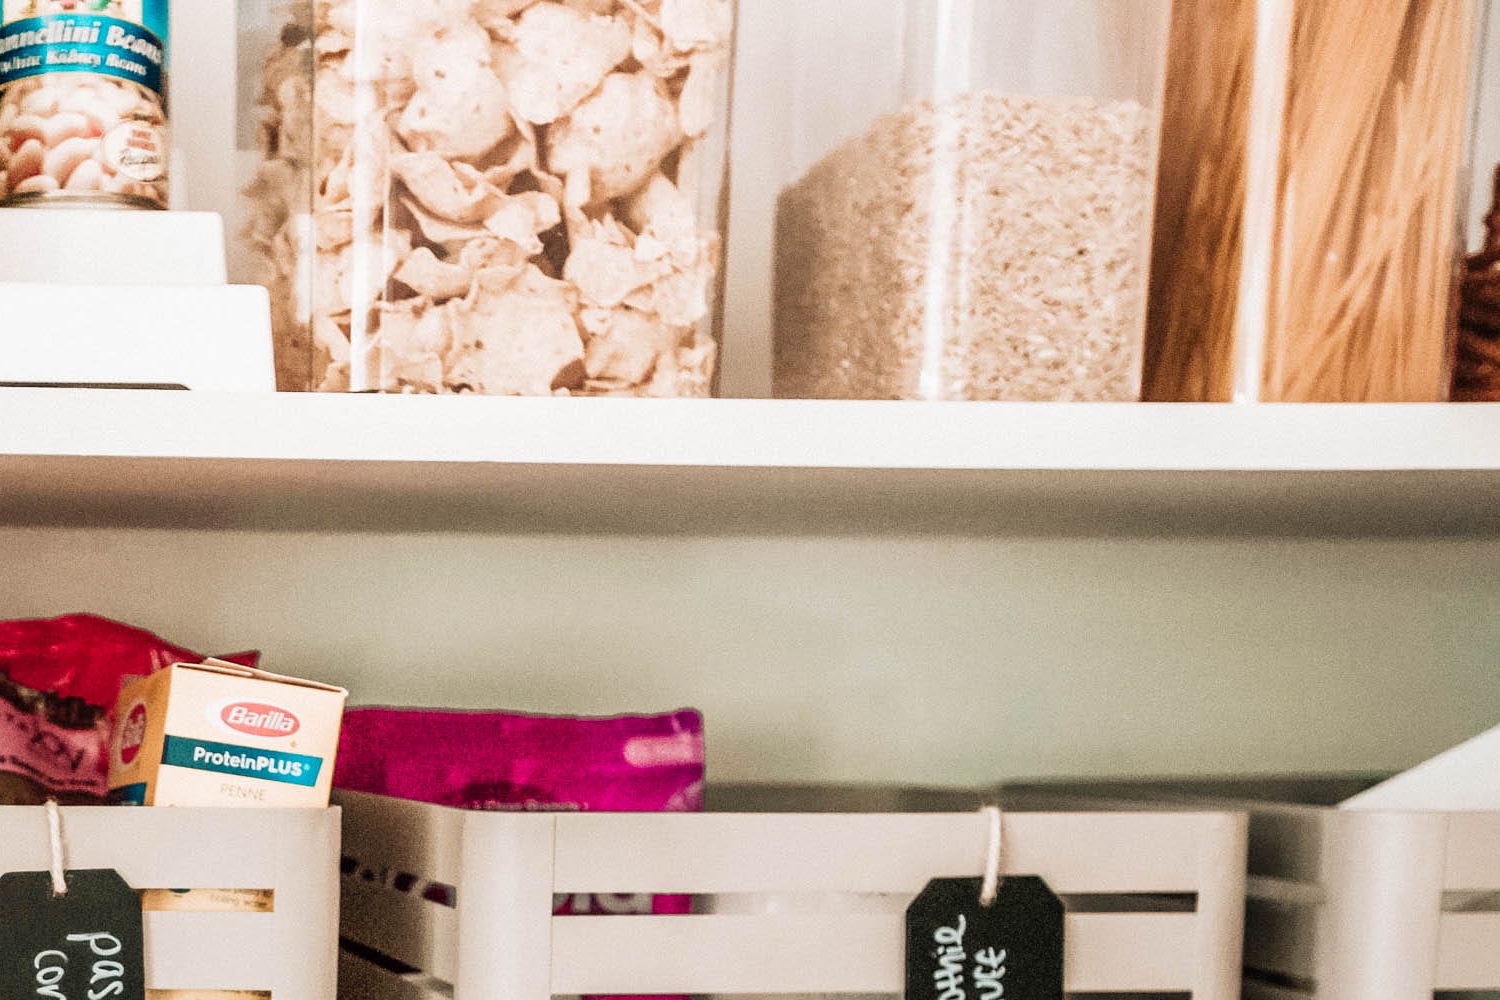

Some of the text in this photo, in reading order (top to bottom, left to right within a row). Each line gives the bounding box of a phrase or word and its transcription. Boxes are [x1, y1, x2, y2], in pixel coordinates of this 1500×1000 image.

[106, 25, 164, 64] Beans
[46, 48, 101, 67] Kidney
[227, 706, 295, 732] Barilla
[220, 783, 267, 801] PENNE
